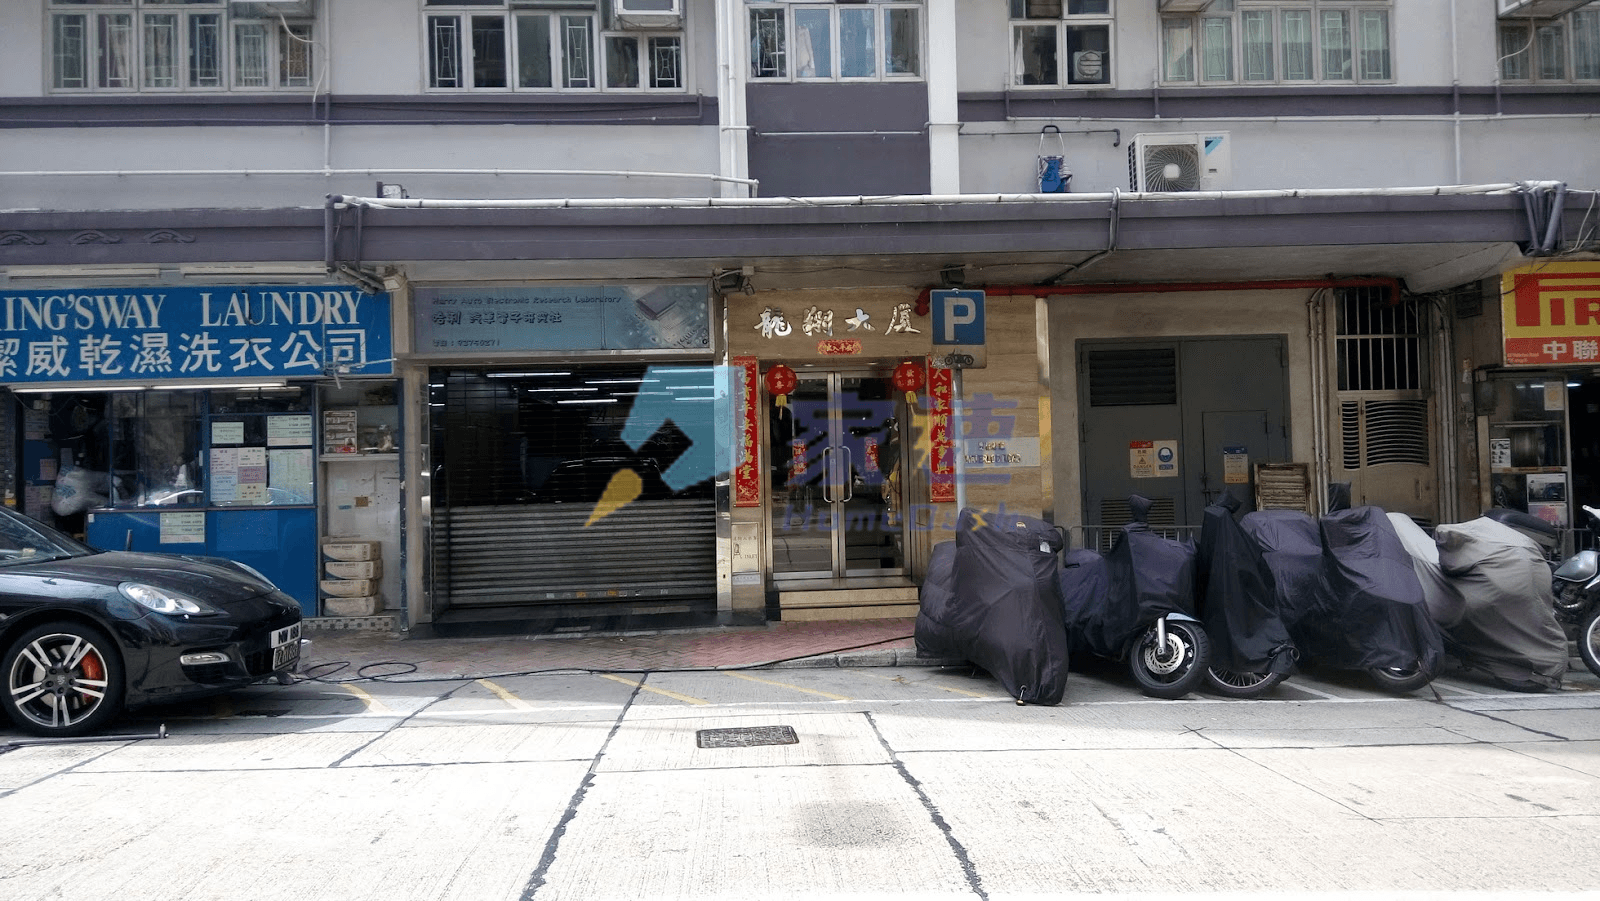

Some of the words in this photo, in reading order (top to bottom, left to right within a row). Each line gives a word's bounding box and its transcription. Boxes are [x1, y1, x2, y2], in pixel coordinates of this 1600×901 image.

[0, 294, 166, 331] ING'SWAY
[200, 291, 363, 328] LAUNDRY
[575, 295, 622, 304] Laboratory
[943, 297, 976, 341] P
[1542, 339, 1599, 361] 中聯
